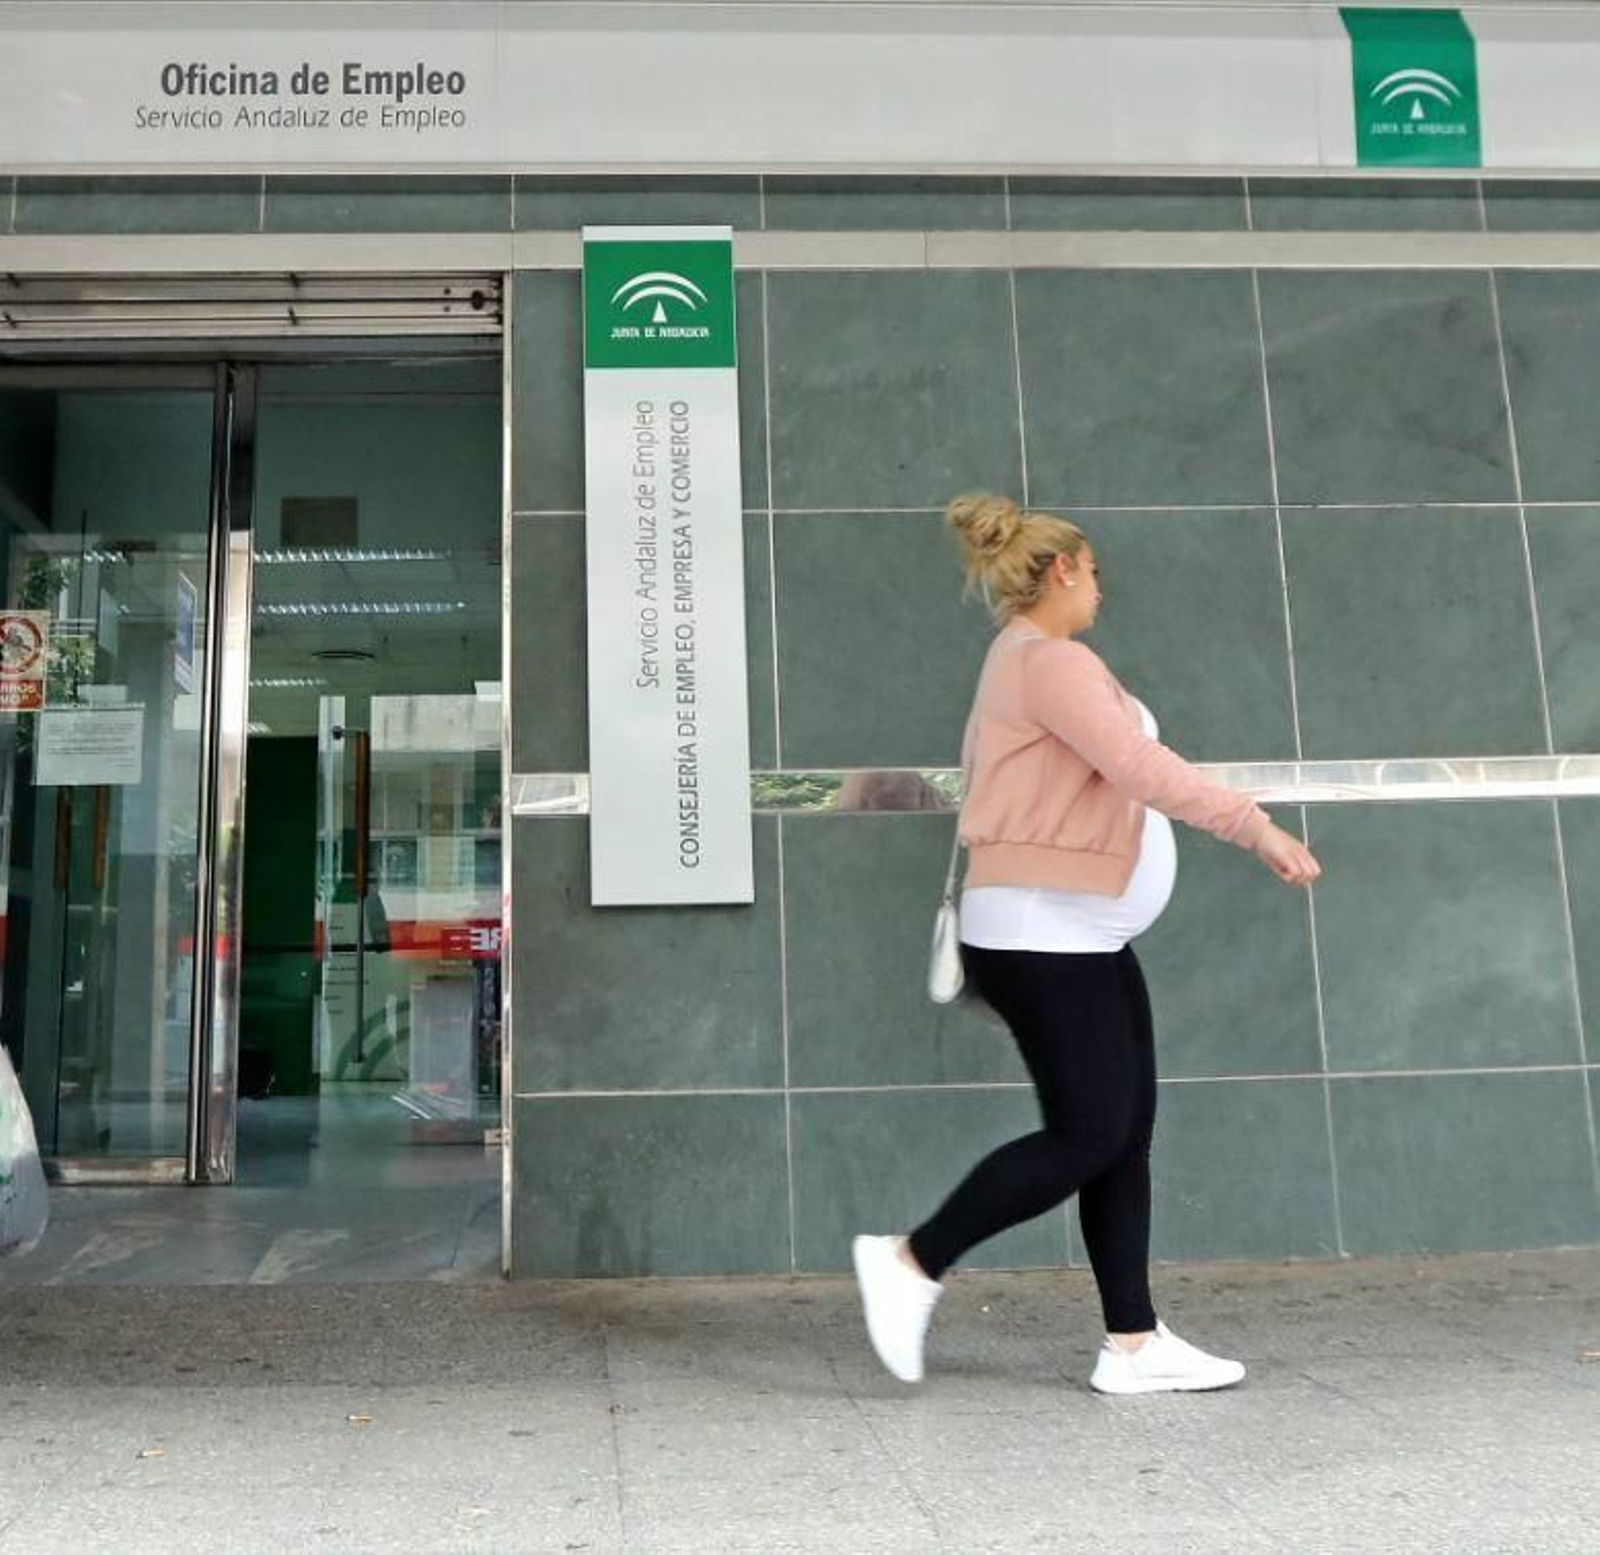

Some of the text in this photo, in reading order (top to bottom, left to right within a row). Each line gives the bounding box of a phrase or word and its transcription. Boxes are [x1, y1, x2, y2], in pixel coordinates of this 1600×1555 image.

[134, 105, 467, 132] Servicio Andaluz de Empleo
[161, 62, 466, 102] Oficina de Empleo
[632, 400, 659, 689] Servicio Andaluz de Empleo
[669, 400, 700, 869] CONSEJERÍA DE EMPLEO, EMPRESA Y COMERCIO
